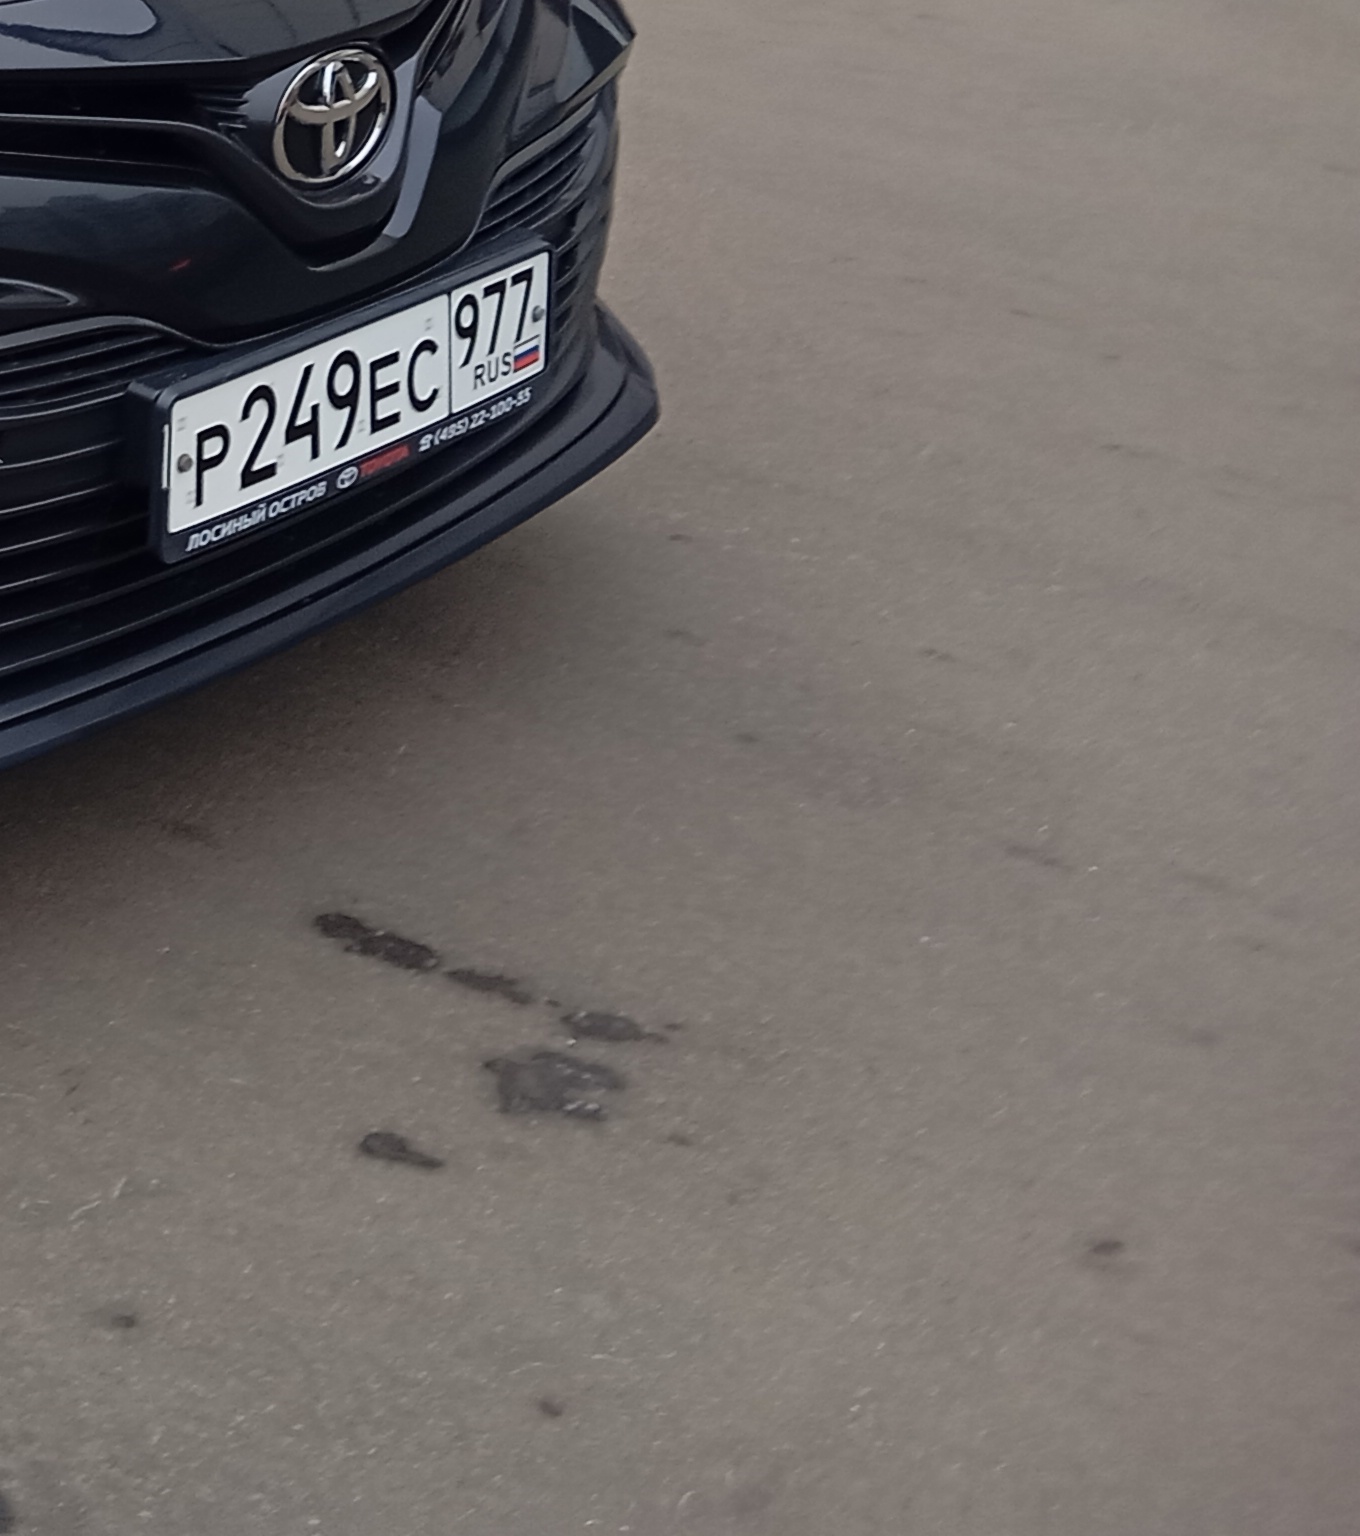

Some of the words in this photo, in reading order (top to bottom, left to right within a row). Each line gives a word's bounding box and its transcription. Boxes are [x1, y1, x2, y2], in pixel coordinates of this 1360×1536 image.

[195, 337, 439, 507] Р249ЕС
[454, 265, 534, 368] 977
[473, 351, 512, 390] RUS
[185, 502, 268, 552] ЛОСИНЫЙ
[268, 480, 328, 518] ОСТРОВ
